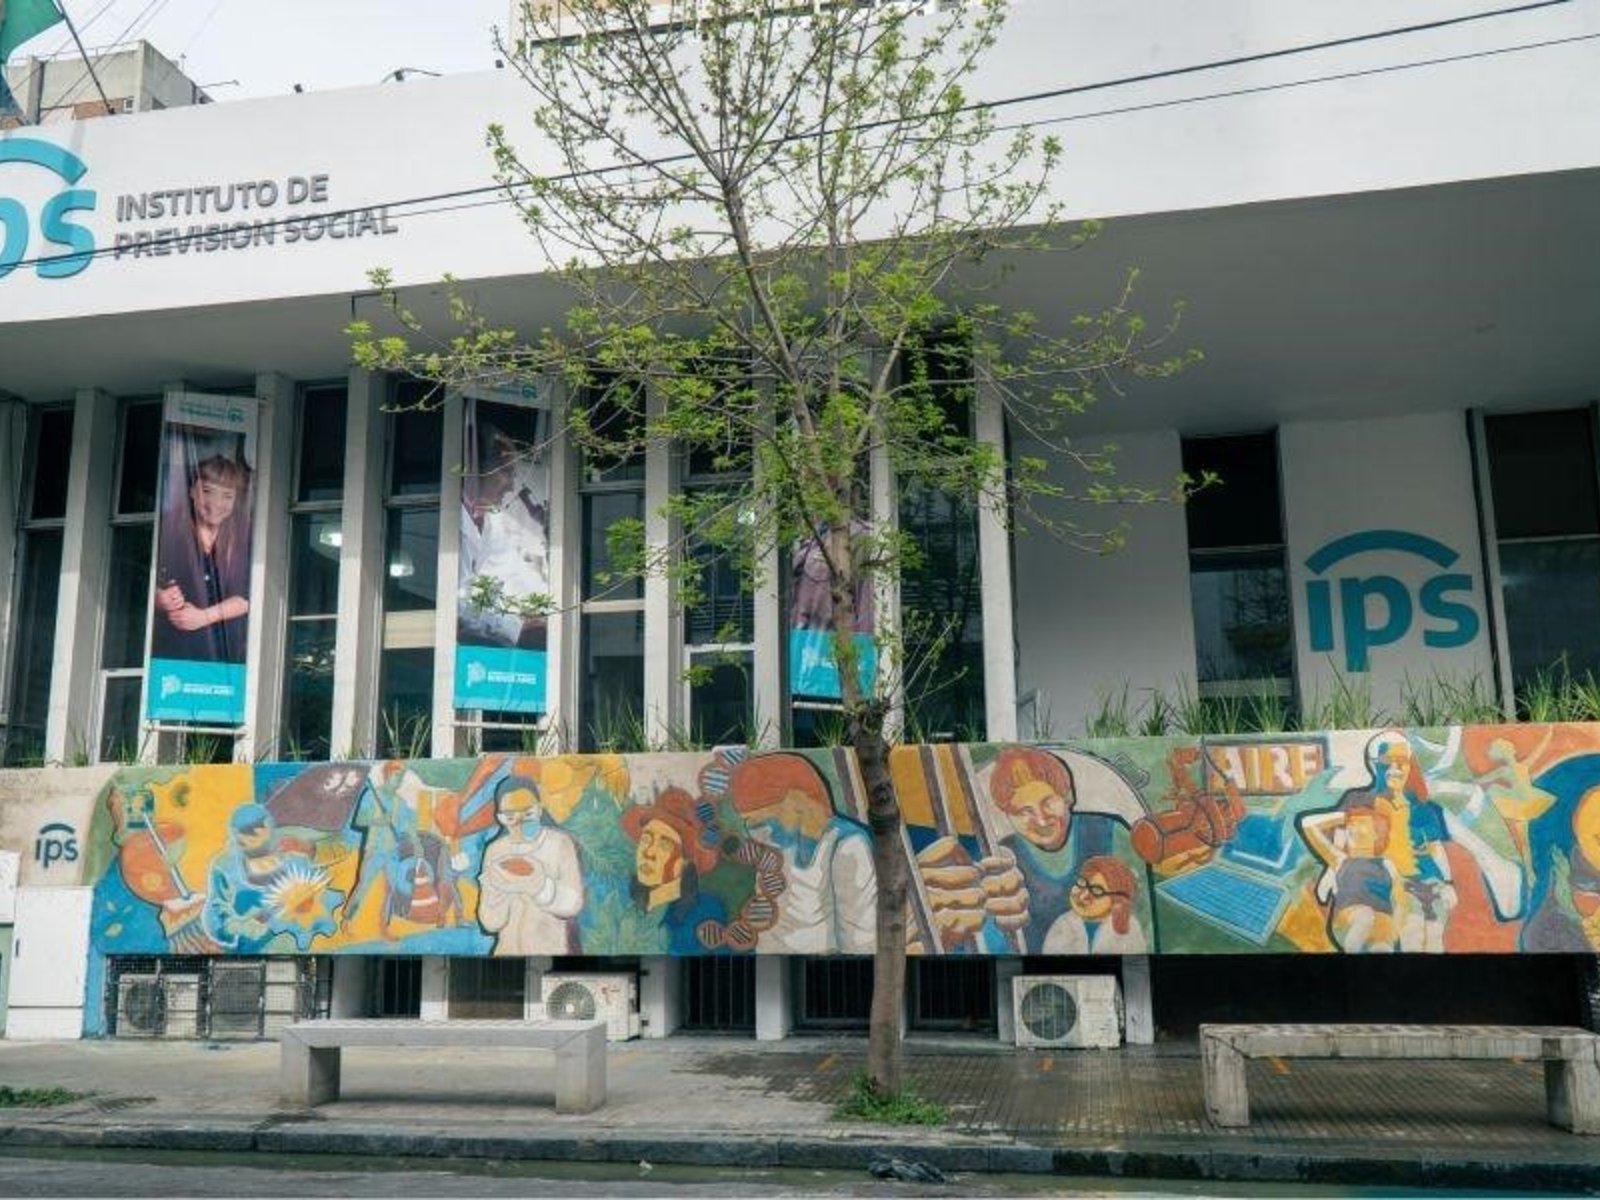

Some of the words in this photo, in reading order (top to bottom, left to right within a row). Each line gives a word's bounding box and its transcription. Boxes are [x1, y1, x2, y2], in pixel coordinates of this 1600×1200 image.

[116, 179, 278, 222] INSTITUTO
[287, 173, 329, 205] DE
[114, 218, 276, 260] PREVISION
[283, 205, 399, 243] SOCIAL
[1305, 573, 1480, 673] ips
[1206, 744, 1320, 791] AIRE
[35, 838, 79, 868] ips
